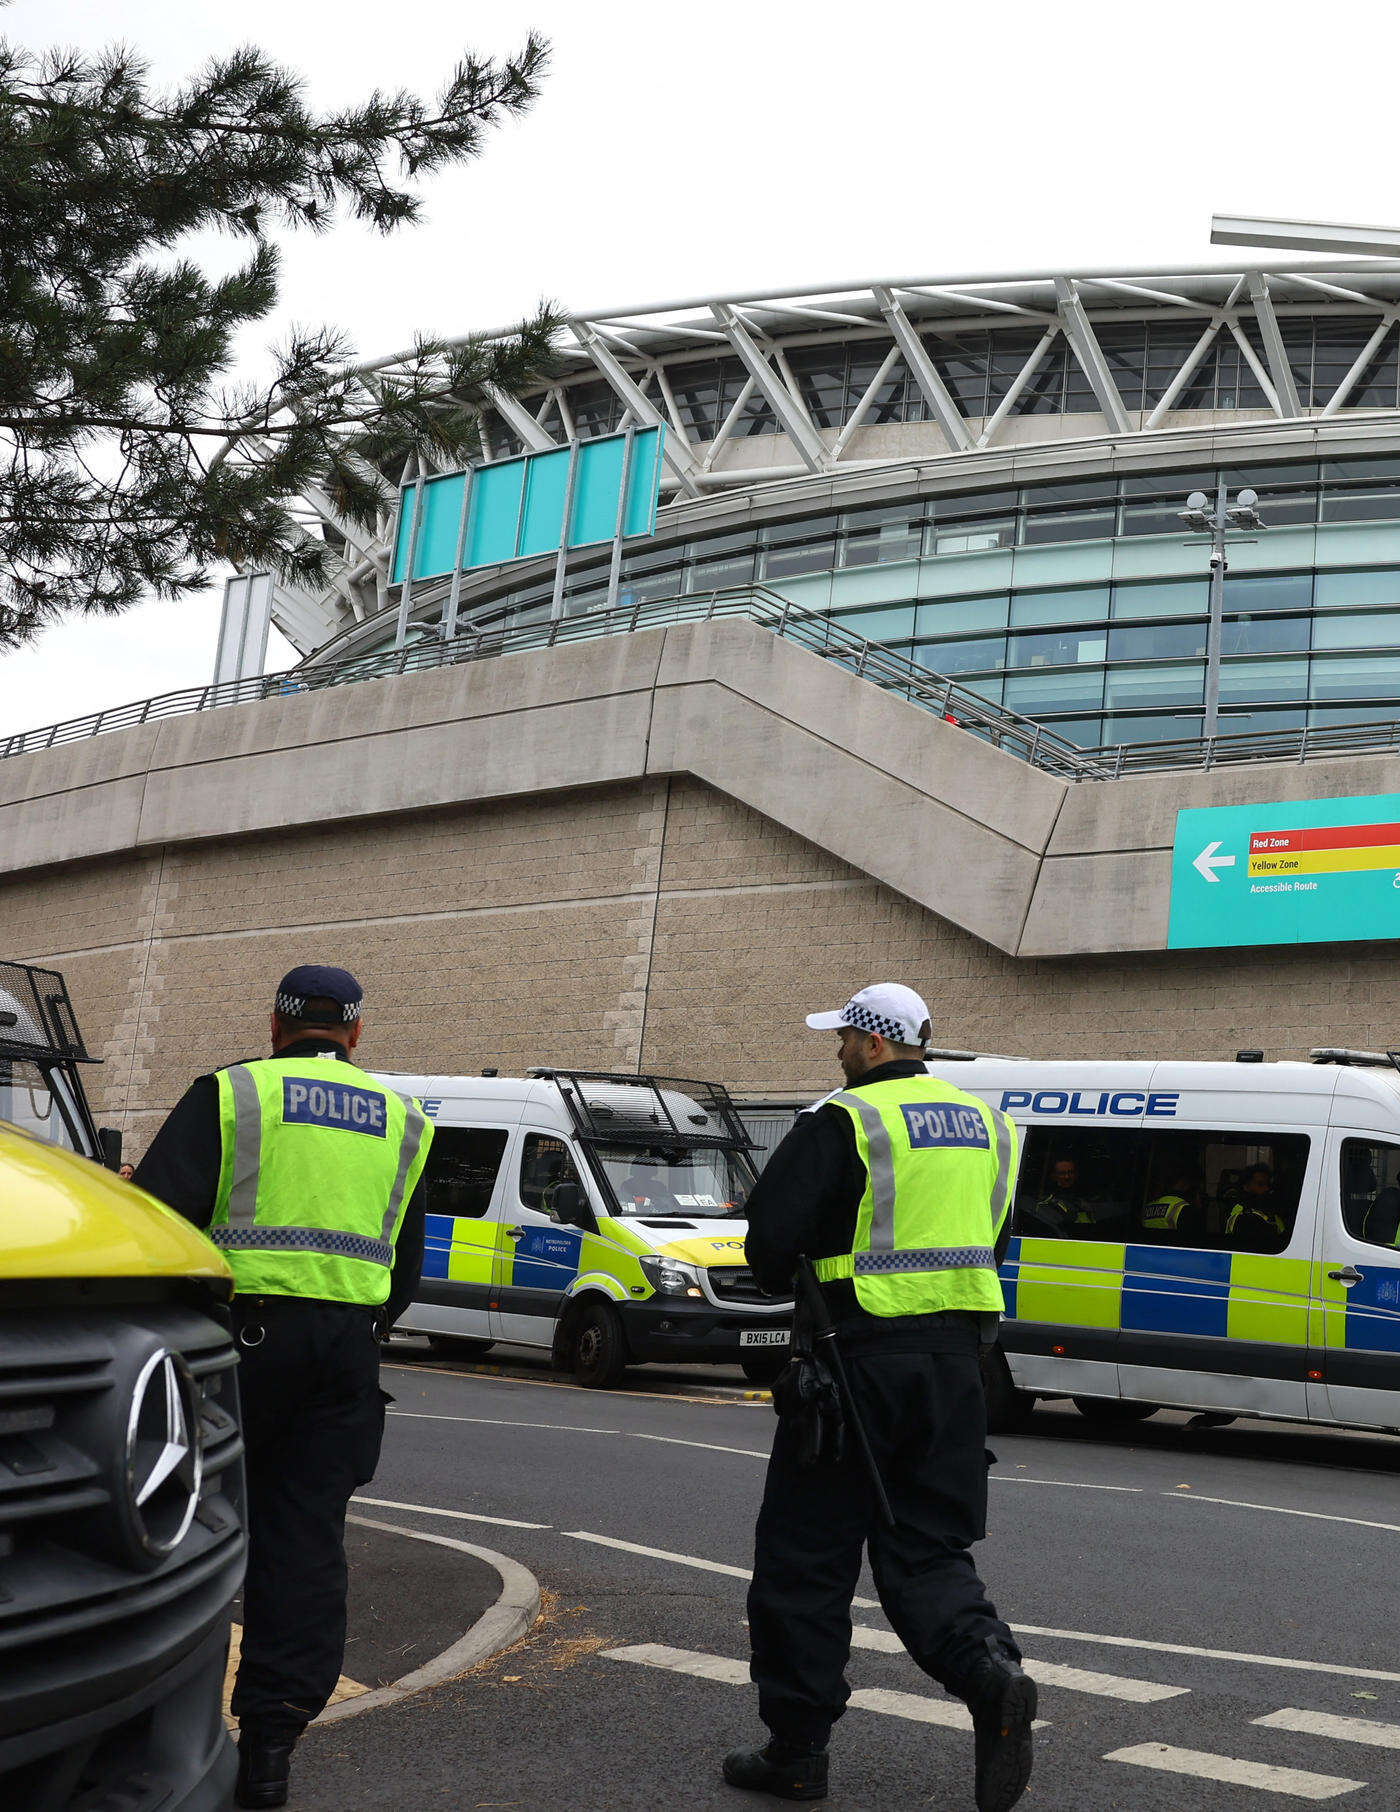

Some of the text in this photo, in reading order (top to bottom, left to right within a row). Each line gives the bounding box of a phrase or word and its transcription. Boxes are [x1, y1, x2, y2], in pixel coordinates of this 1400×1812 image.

[1252, 838, 1290, 848] Red Zone
[1251, 859, 1299, 870] Yellow Zone
[1249, 881, 1318, 894] Accessible Route
[289, 1084, 383, 1128] POLICE
[1000, 1091, 1180, 1116] POLICE
[908, 1110, 987, 1140] POLICE
[548, 1245, 567, 1253] POLICE
[710, 1241, 745, 1251] PO
[746, 1332, 786, 1344] BX15 LCA
